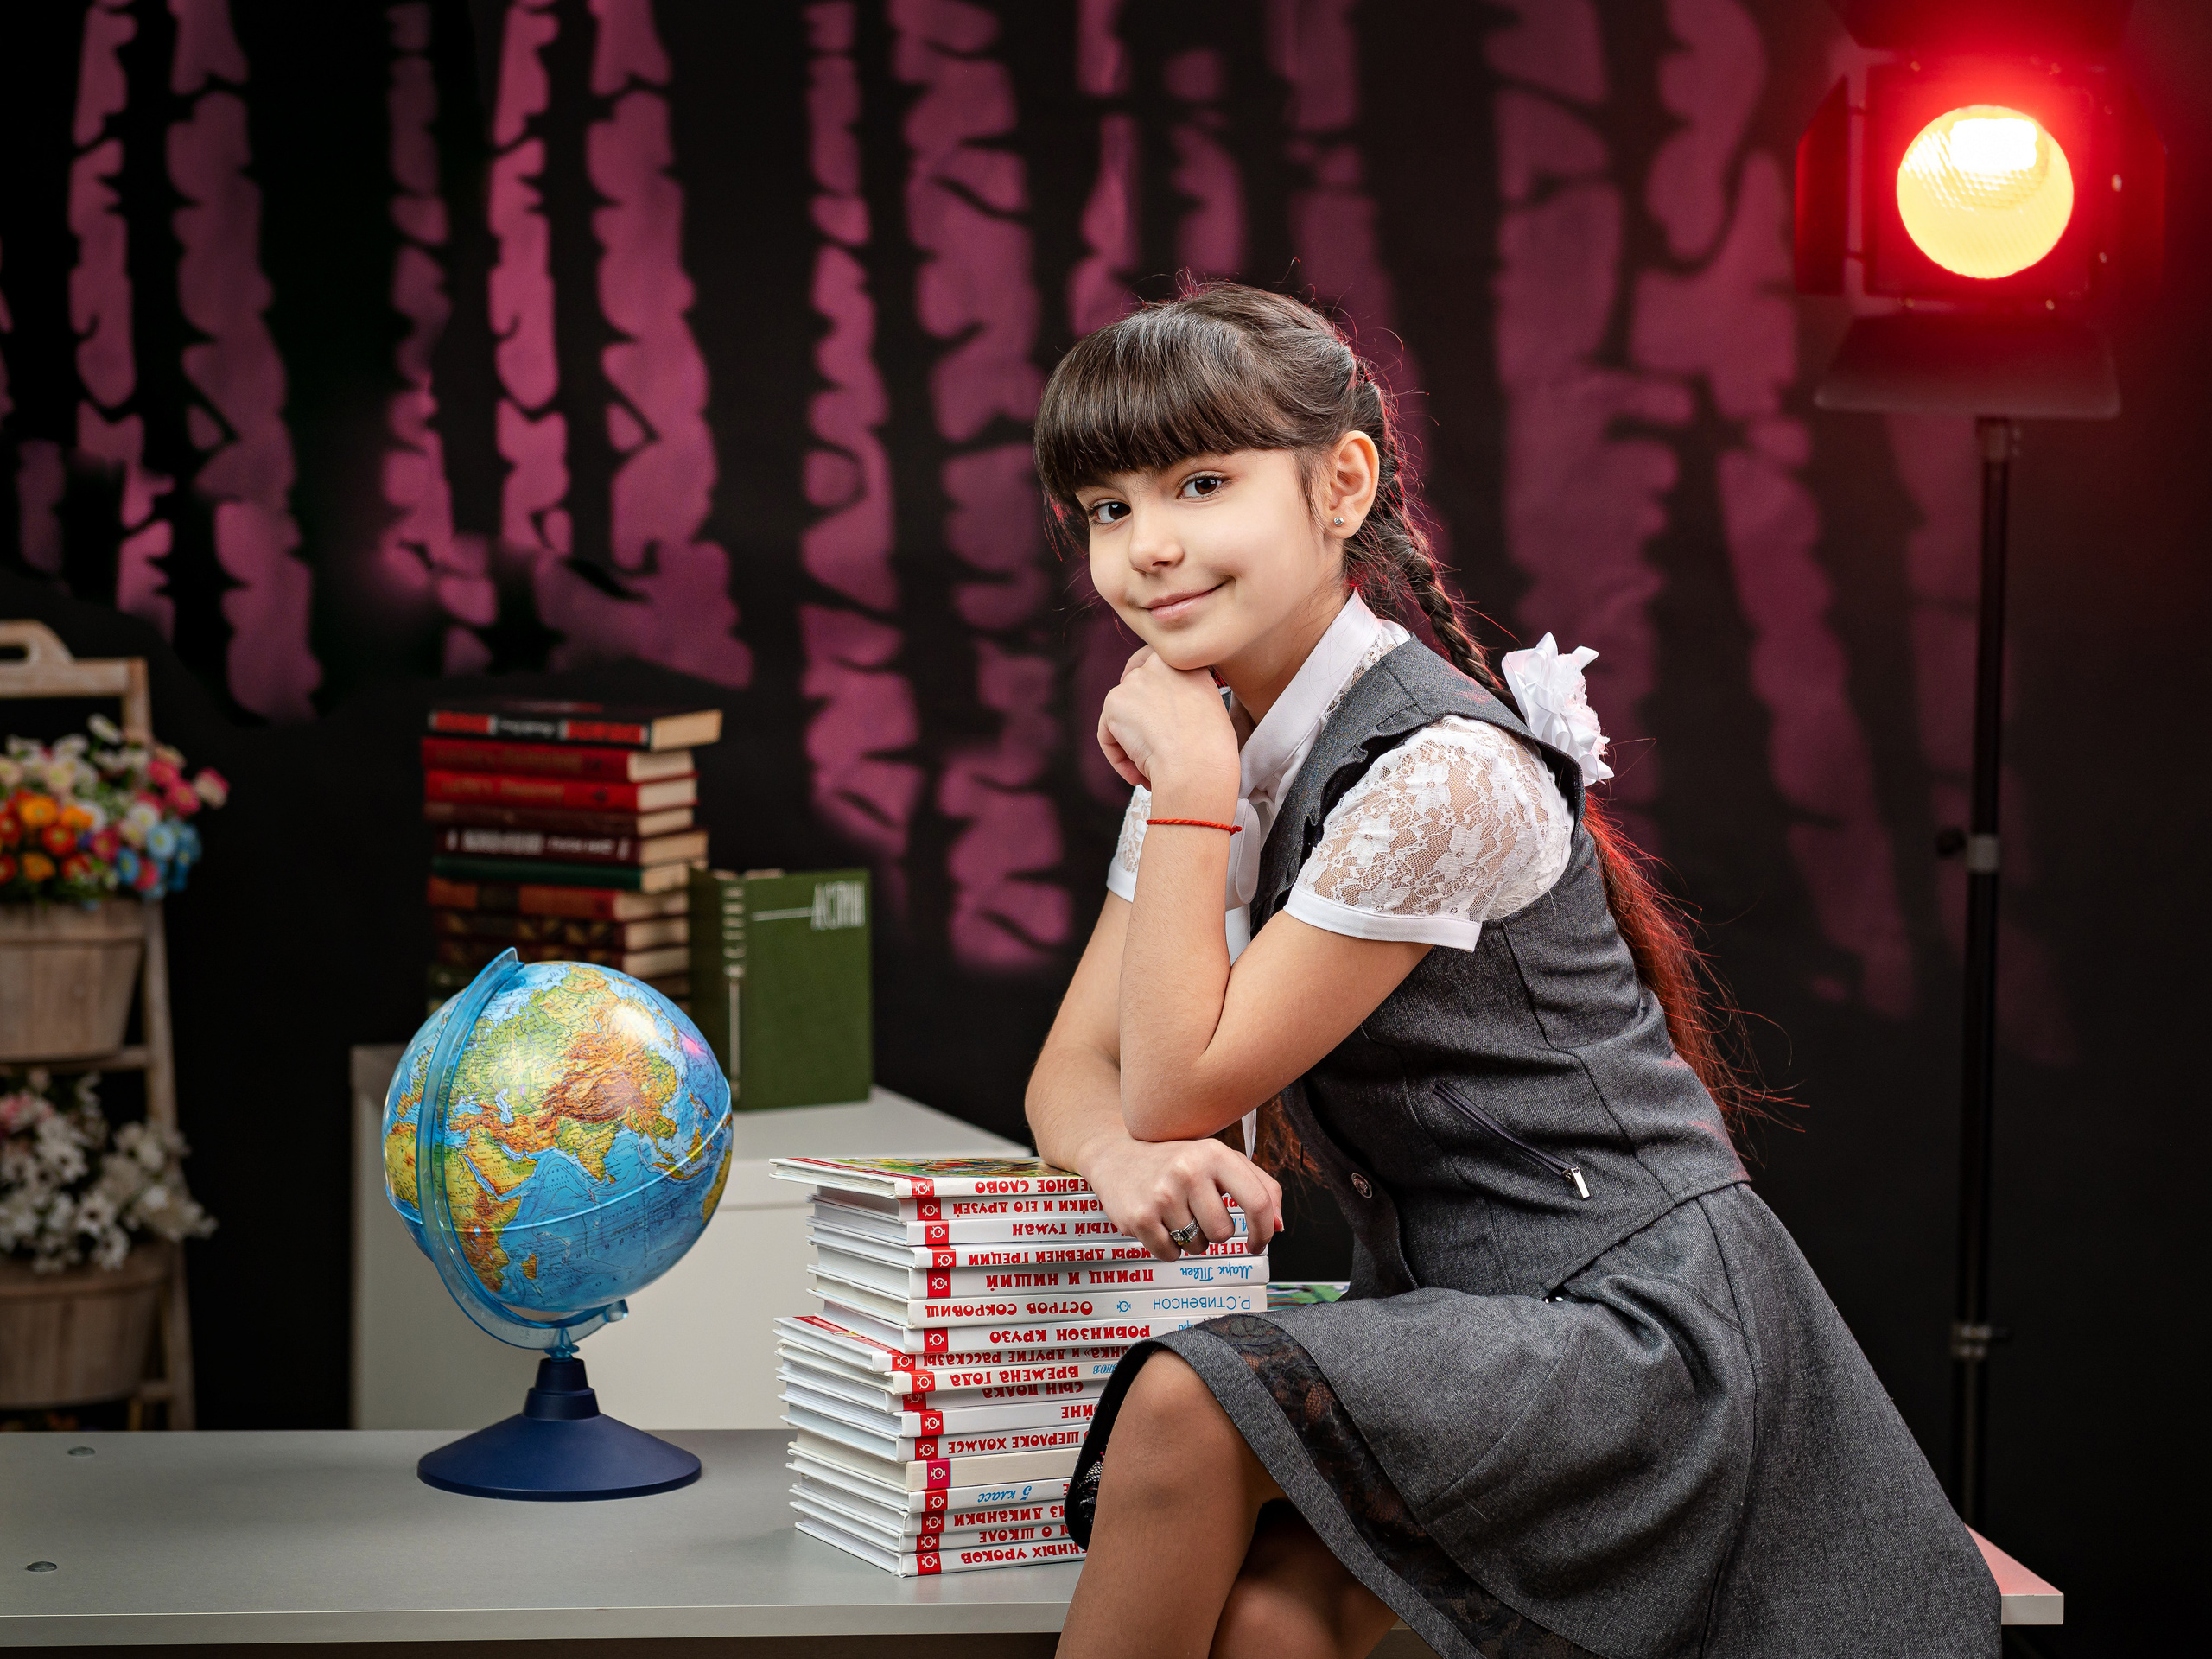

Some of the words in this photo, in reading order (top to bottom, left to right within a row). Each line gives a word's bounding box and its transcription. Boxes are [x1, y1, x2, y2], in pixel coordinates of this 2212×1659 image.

[975, 1179, 1029, 1194] СЛОВО
[1037, 1179, 1093, 1193] ЕБНОЕ
[952, 1201, 1009, 1218] ДРУЗЕЙ
[1014, 1200, 1038, 1213] ЕГО
[1043, 1200, 1053, 1212] И
[1012, 1223, 1067, 1236] ТУМАН
[969, 1251, 1029, 1266] ГРЕЦИИ
[1035, 1249, 1105, 1264] ДРЕВНЕЙ
[1068, 1271, 1080, 1285] И
[1088, 1269, 1154, 1284] ПРИНЦ
[1179, 1266, 1214, 1281] Твен
[1217, 1263, 1253, 1280] Марк
[986, 1273, 1058, 1292] НИЩИЙ
[989, 1329, 1046, 1344] КРУЗО
[1056, 1325, 1150, 1341] РОБИНЗОН
[1008, 1348, 1065, 1363] ДРУГИЕ
[950, 1371, 992, 1387] ГОДА
[999, 1365, 1079, 1383] ВРЕМЕНА
[981, 1384, 1039, 1399] ПОЛКА
[1046, 1382, 1084, 1395] СЫН
[948, 1437, 1007, 1454] ХОЛМСЕ
[1011, 1431, 1079, 1449] ШЕРЛОКЕ
[977, 1490, 1017, 1503] класс
[1020, 1485, 1033, 1501] 5
[953, 1507, 1044, 1527] ДИКАНЬКИ
[979, 1527, 1035, 1543] ШКОЛЕ
[1041, 1526, 1052, 1538] О
[961, 1548, 1027, 1564] УРОКОВ
[1032, 1542, 1088, 1558] ННЫХ
